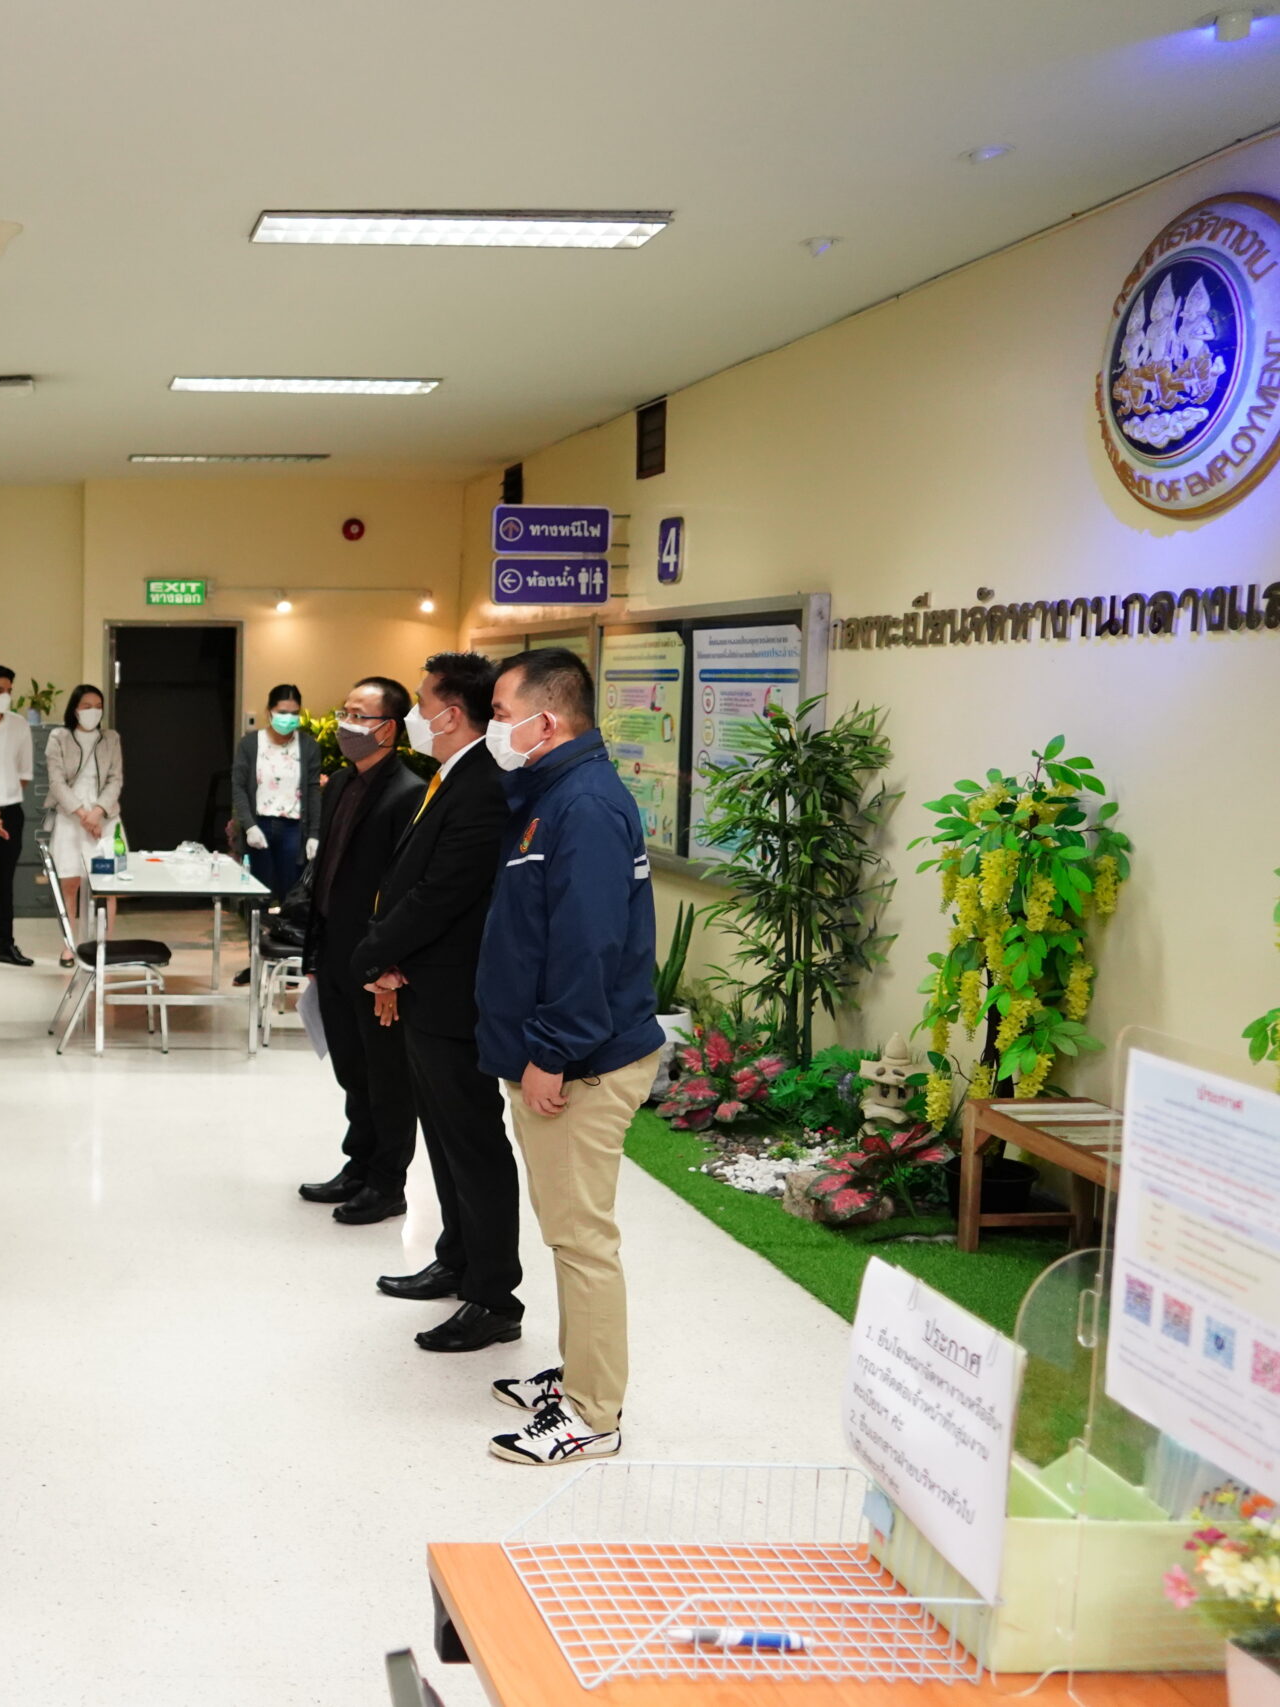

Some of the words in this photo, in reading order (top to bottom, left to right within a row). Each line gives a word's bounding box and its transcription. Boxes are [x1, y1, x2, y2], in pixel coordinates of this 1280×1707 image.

[1156, 477, 1183, 503] OF
[1183, 330, 1280, 498] EMPLOYMENT
[528, 520, 601, 538] ทางหนีไฟ
[661, 526, 678, 573] 4
[149, 581, 202, 593] EXIT
[525, 566, 576, 588] ห้องน้ำ
[150, 593, 202, 604] ทางออก
[924, 1318, 982, 1377] ประกาศ
